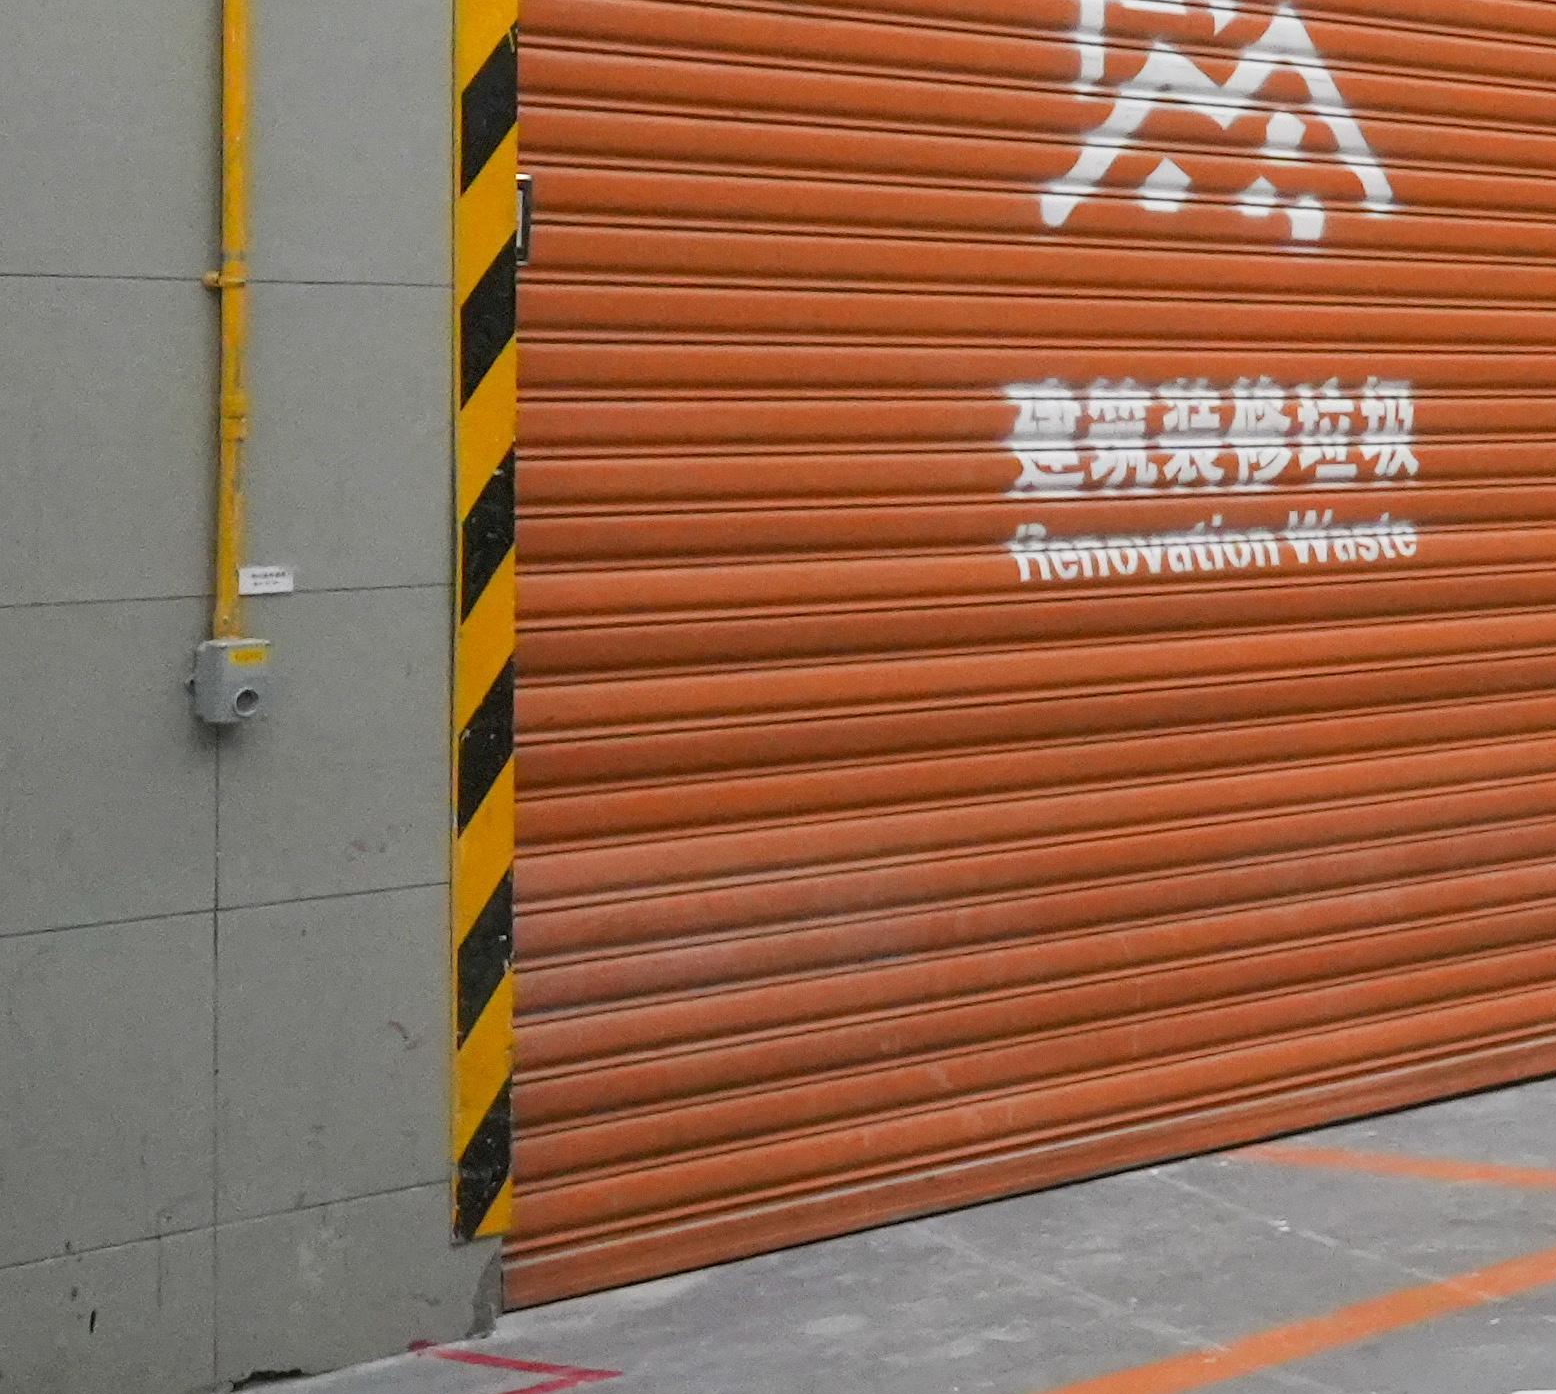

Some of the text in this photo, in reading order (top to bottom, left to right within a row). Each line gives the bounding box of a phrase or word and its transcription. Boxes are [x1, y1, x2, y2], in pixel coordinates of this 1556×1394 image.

[1008, 379, 1420, 491] 建筑装修垃圾
[1012, 511, 1419, 583] Renovation Waste
